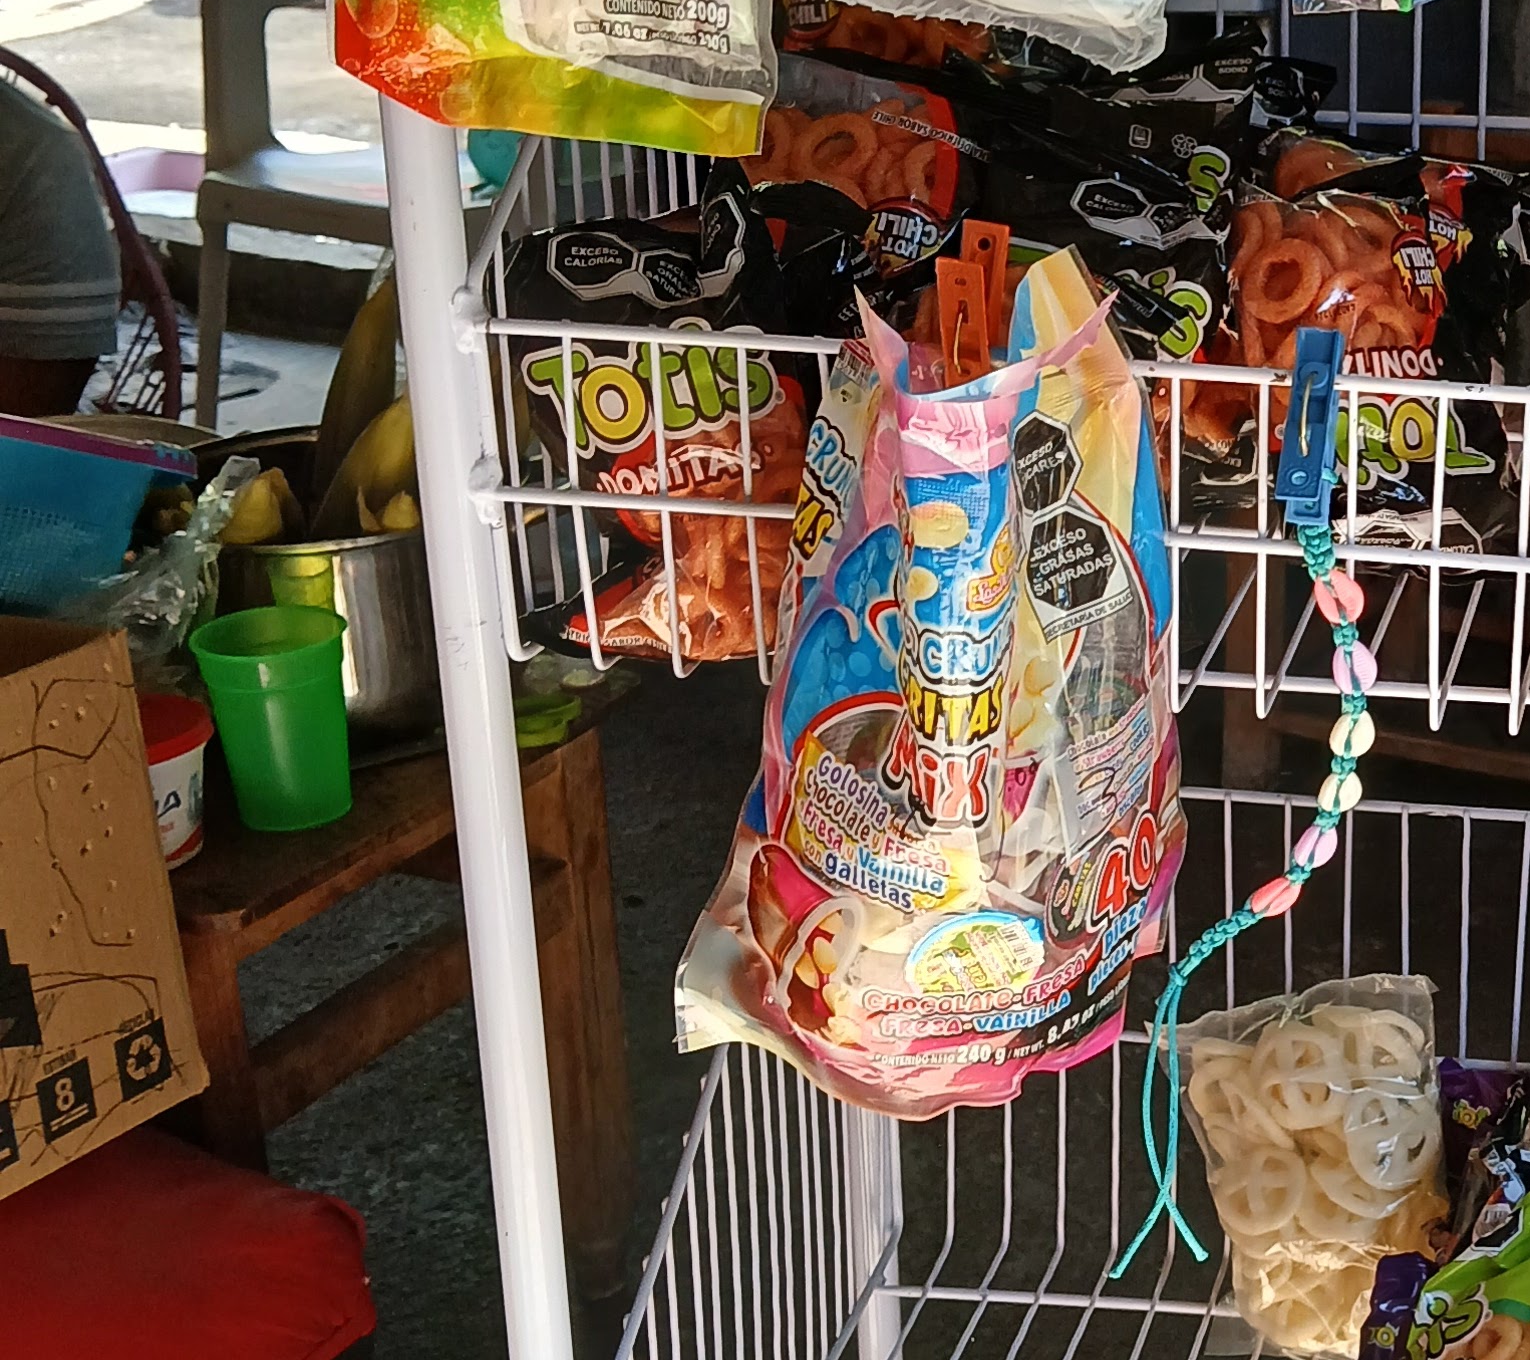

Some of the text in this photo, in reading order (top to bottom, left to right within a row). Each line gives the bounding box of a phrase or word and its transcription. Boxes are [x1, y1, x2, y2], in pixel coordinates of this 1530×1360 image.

[687, 0, 729, 28] 200g
[789, 3, 828, 26] CHILI
[898, 116, 929, 137] SABOR
[877, 211, 939, 246] CHILI
[1429, 221, 1457, 239] HOT
[881, 236, 921, 258] HOT
[1399, 247, 1436, 269] CHILI
[1415, 270, 1435, 285] HOT
[1033, 528, 1087, 561] EXCESO
[1038, 542, 1095, 574] GRASAS
[1033, 553, 1114, 597] SATURADAS
[818, 754, 889, 827] Golosina
[805, 769, 871, 841] Chocolate
[885, 837, 947, 873] Fresa
[803, 801, 844, 852] Fresa
[858, 847, 944, 893] Vainilla
[804, 841, 912, 909] con galletas
[1094, 814, 1157, 921] 40
[957, 1046, 990, 1064] 240
[992, 1047, 1006, 1065] g
[54, 1077, 75, 1112] 8
